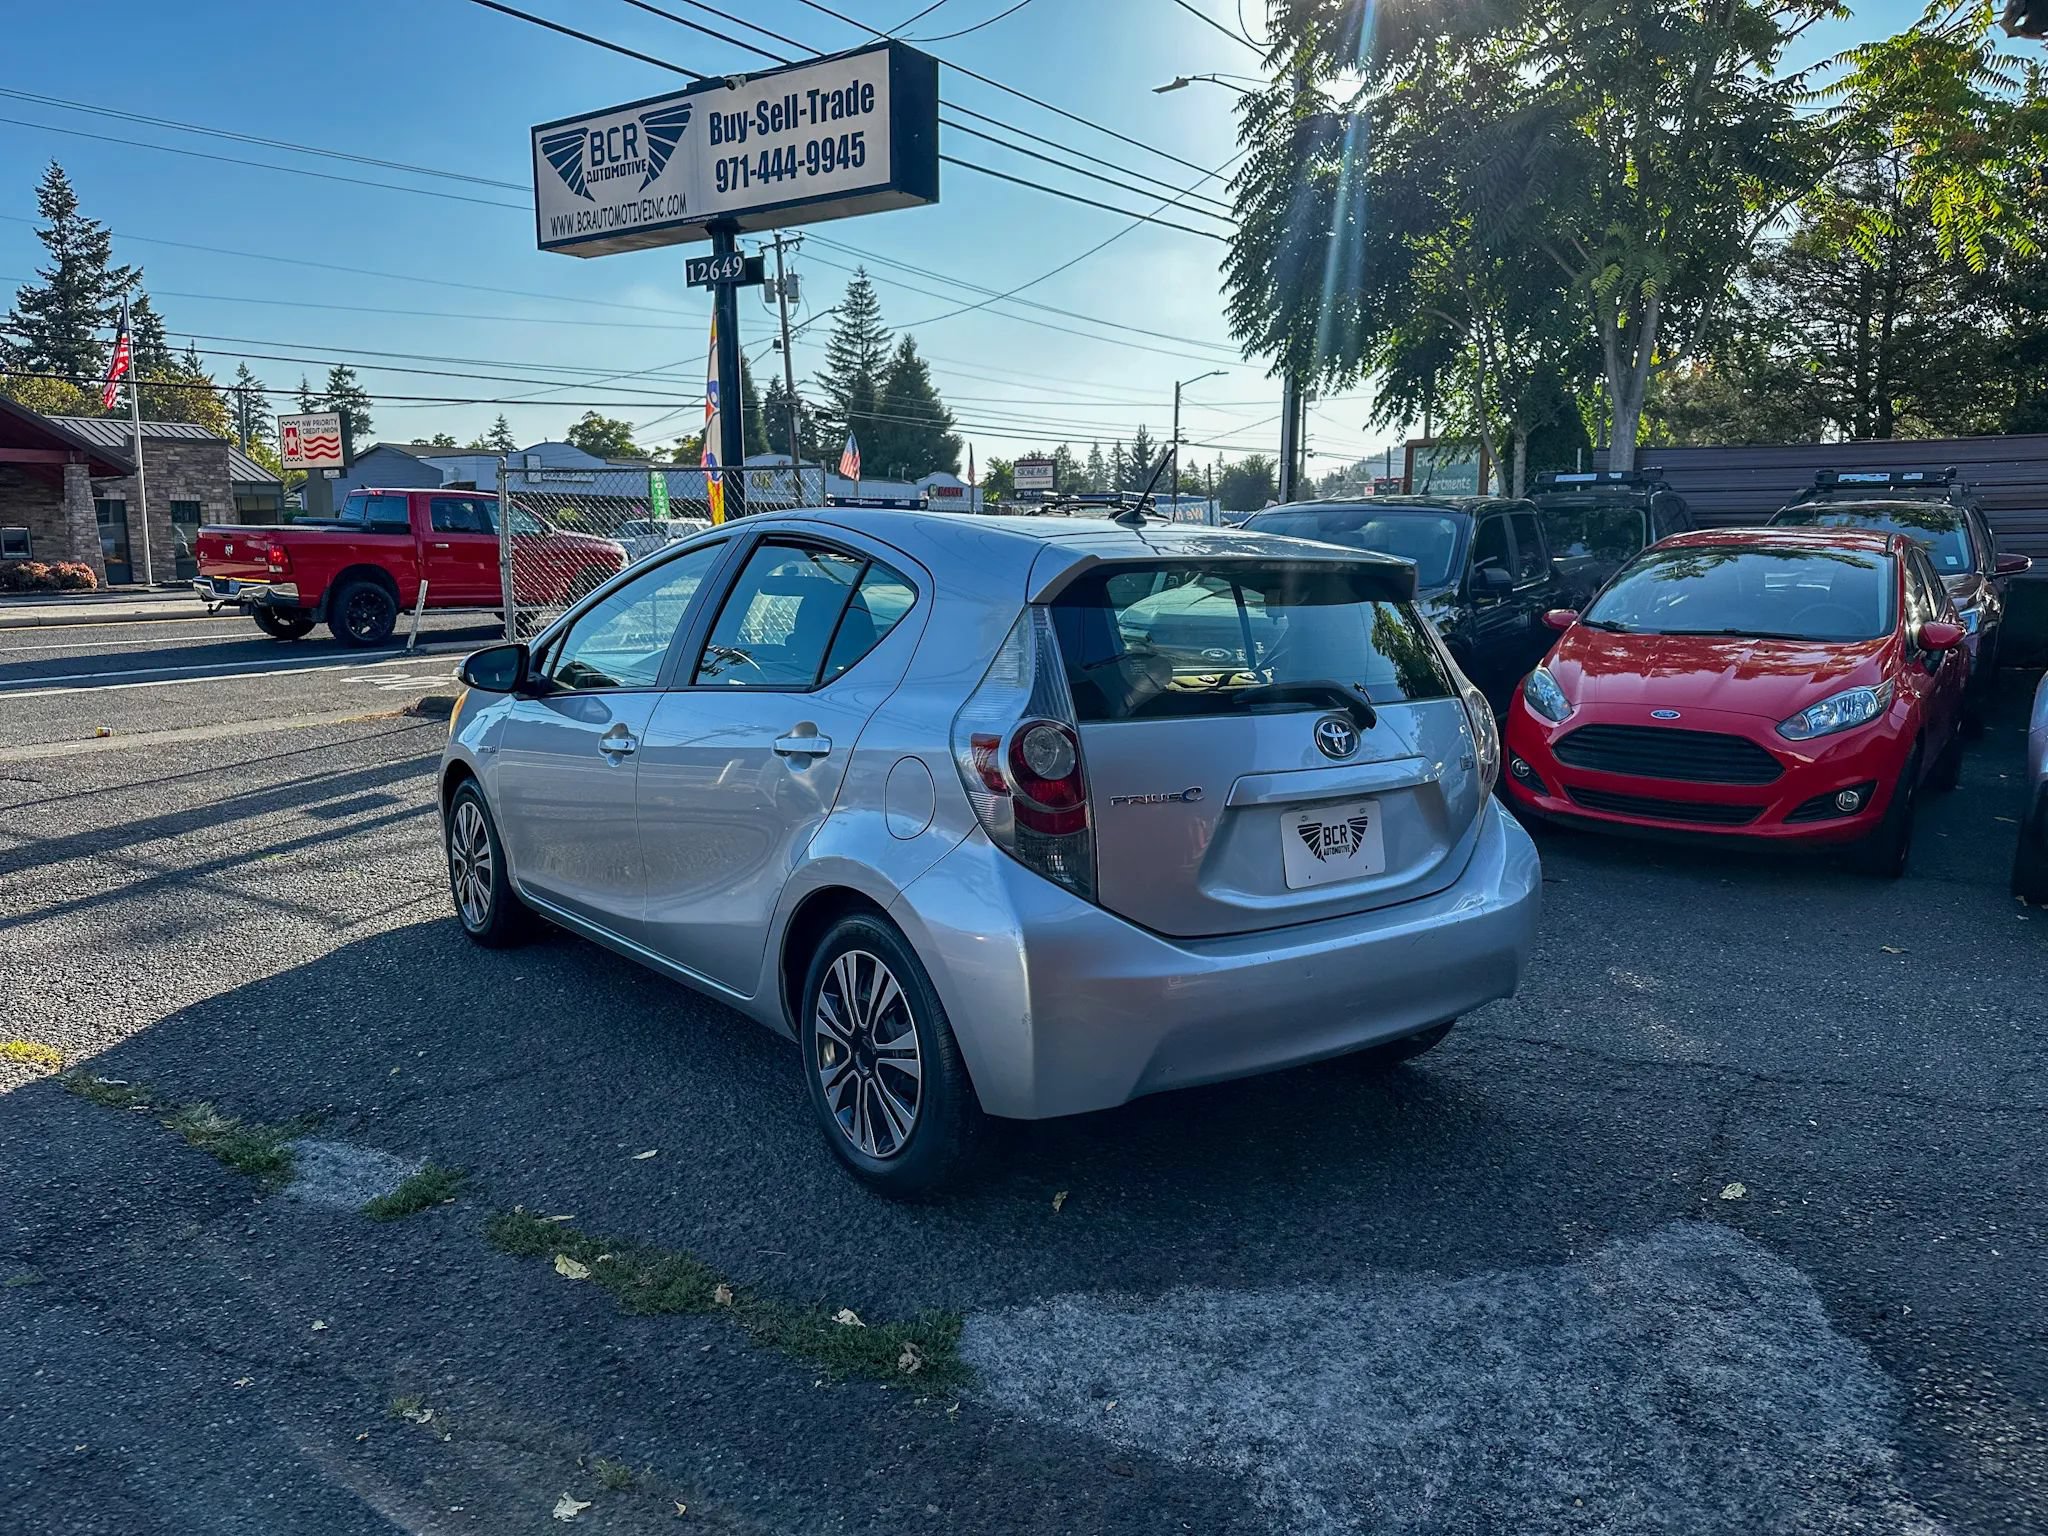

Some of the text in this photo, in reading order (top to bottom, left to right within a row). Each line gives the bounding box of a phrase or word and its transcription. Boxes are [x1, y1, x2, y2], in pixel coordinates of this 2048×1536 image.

[709, 79, 875, 146] Buy-Sell-Trade
[590, 123, 639, 168] BCR
[715, 130, 866, 193] 971-444-9945
[586, 159, 647, 184] AUTOMOTIVE
[550, 192, 688, 237] WWW.BCRAUTOMOTIVEINC.COM
[687, 255, 744, 283] 12649
[1323, 824, 1348, 846] BCR
[1323, 844, 1351, 856] AUTOMOTIVE
